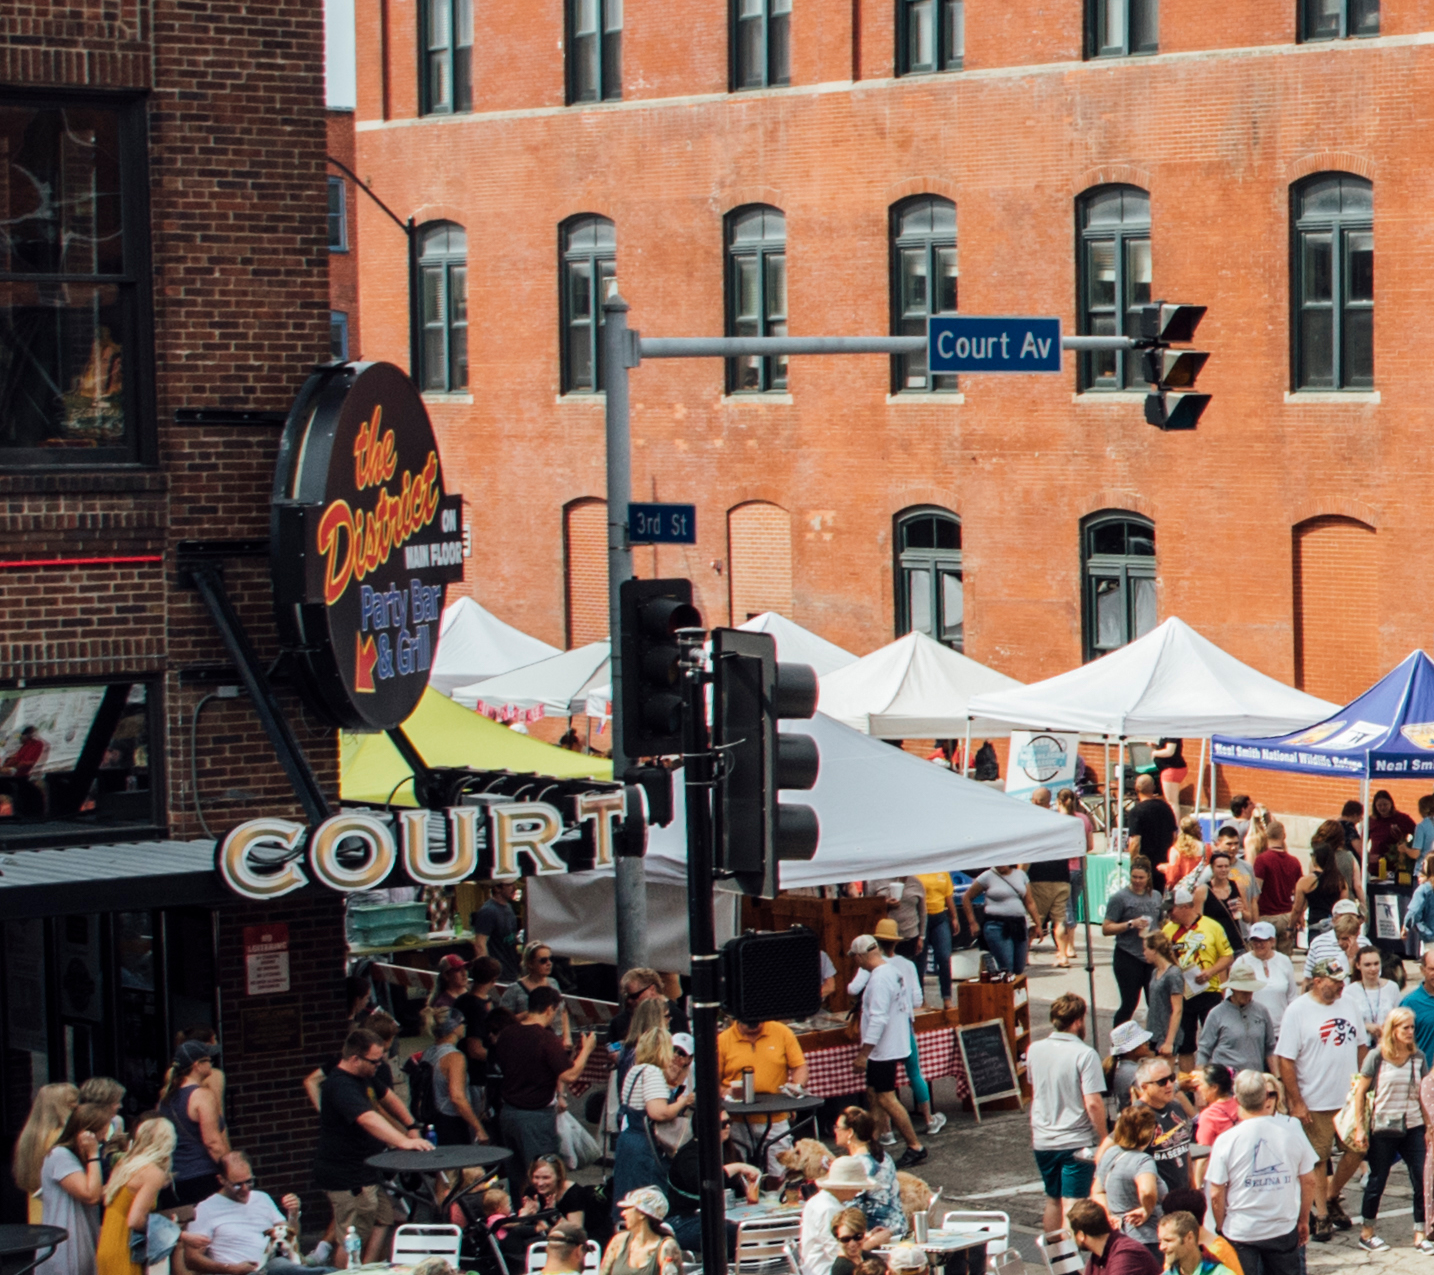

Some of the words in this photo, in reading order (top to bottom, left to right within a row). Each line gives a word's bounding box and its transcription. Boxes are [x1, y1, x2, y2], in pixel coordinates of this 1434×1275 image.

[937, 330, 1010, 360] Court
[1020, 331, 1052, 359] Av
[354, 405, 397, 491] the
[317, 450, 439, 606] District
[637, 512, 661, 535] 3rd
[671, 513, 687, 536] St
[360, 582, 408, 632] Party
[410, 578, 441, 625] Bar
[377, 632, 394, 681] &
[396, 624, 431, 676] Grill
[1214, 743, 1235, 756] Neal
[1236, 745, 1261, 759] Smith
[1262, 749, 1298, 764] National
[1376, 759, 1407, 771] Neal
